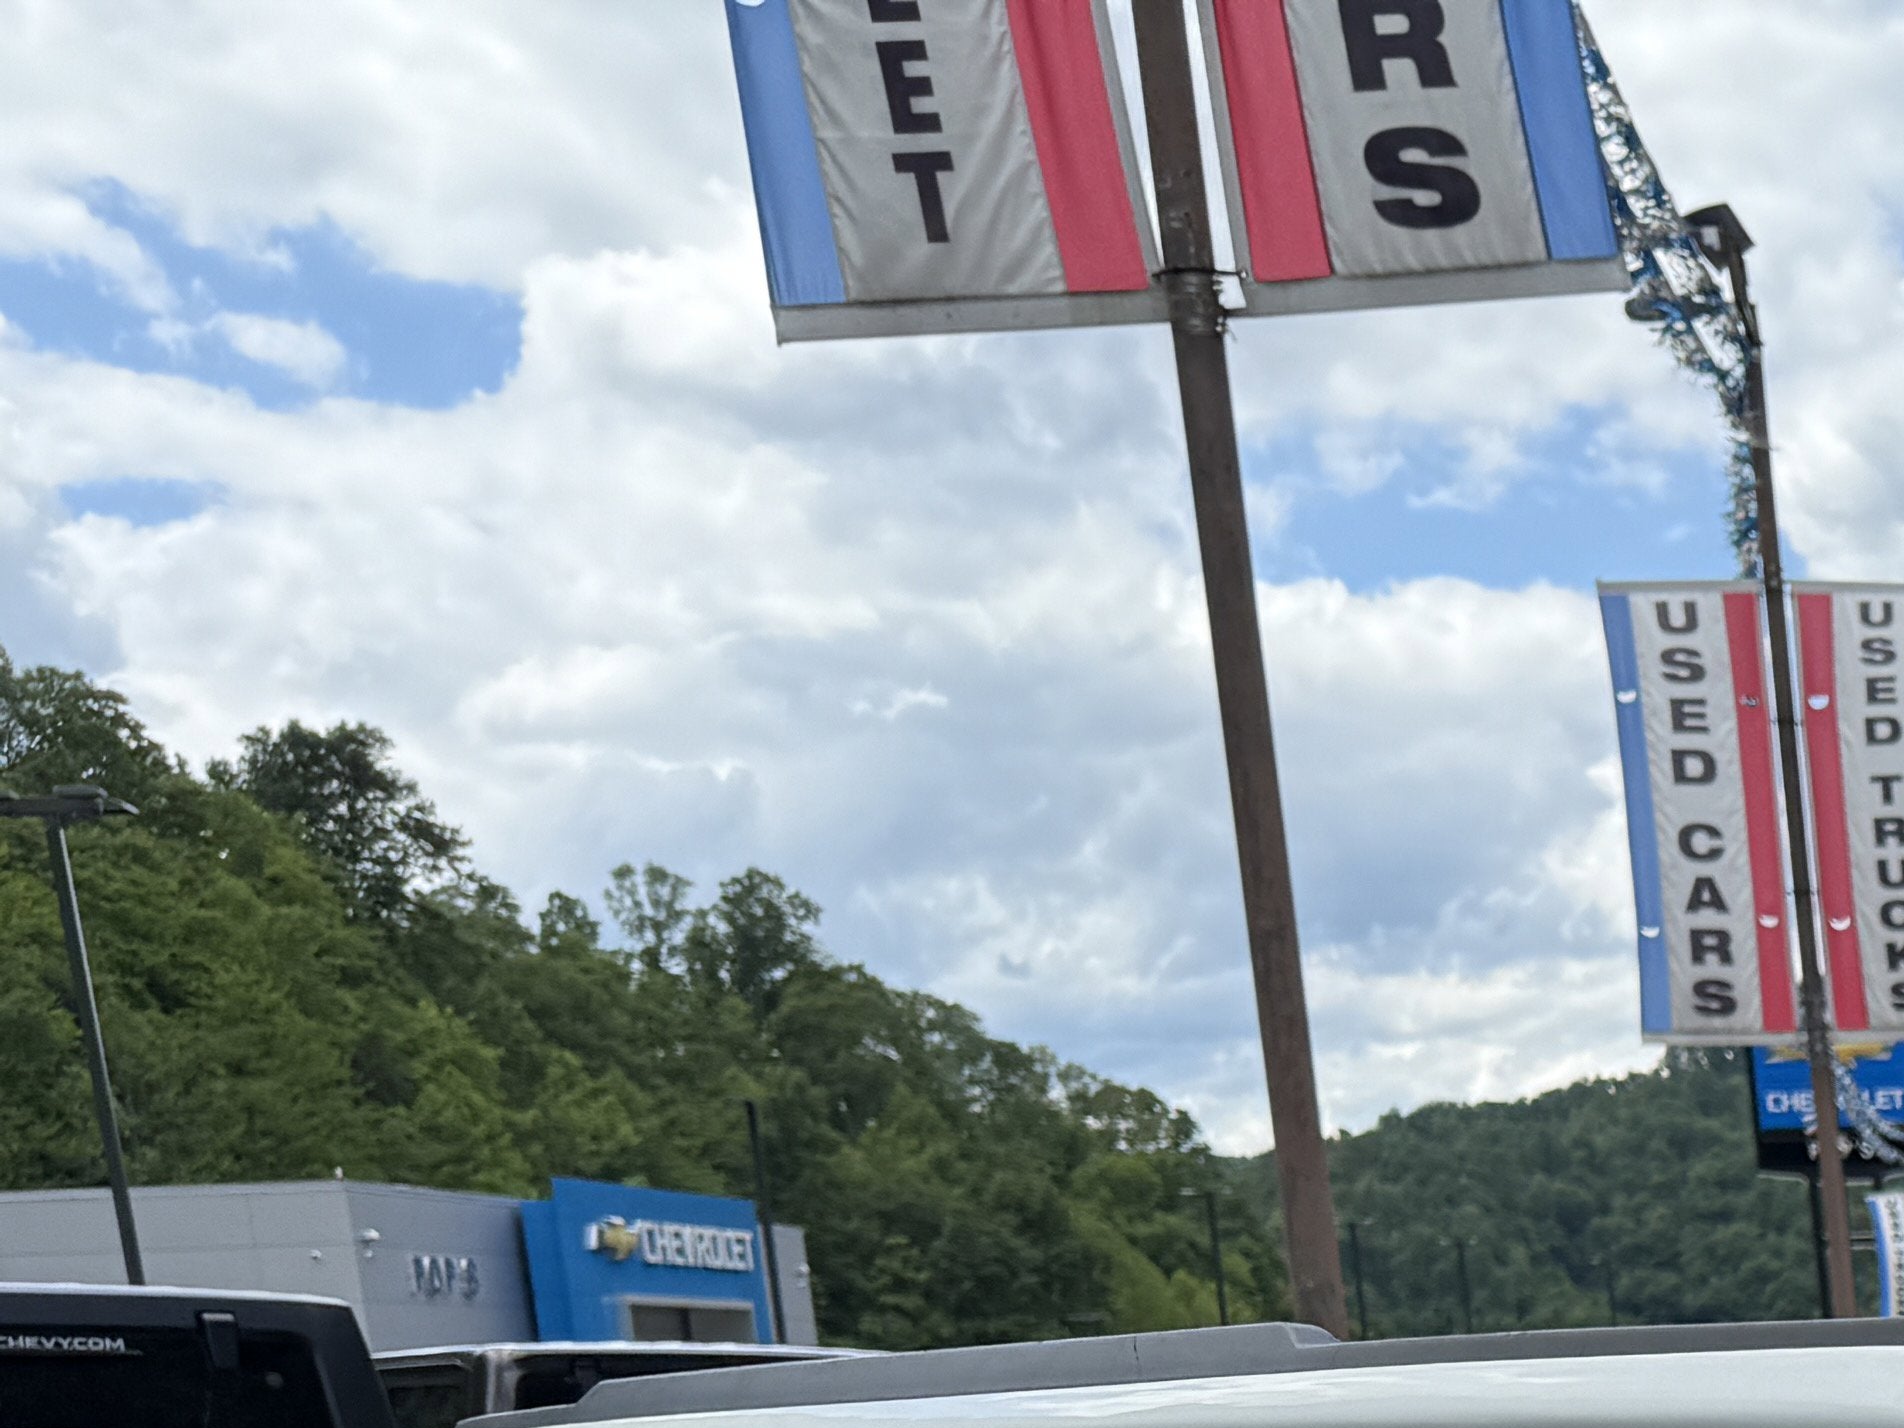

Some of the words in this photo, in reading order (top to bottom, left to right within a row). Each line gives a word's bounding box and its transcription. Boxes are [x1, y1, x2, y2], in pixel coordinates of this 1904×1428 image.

[868, 0, 954, 243] ET
[1656, 600, 1718, 785] USED
[1860, 602, 1902, 746] USED
[1677, 823, 1738, 1018] CARS
[641, 1220, 754, 1273] CHEVROLET
